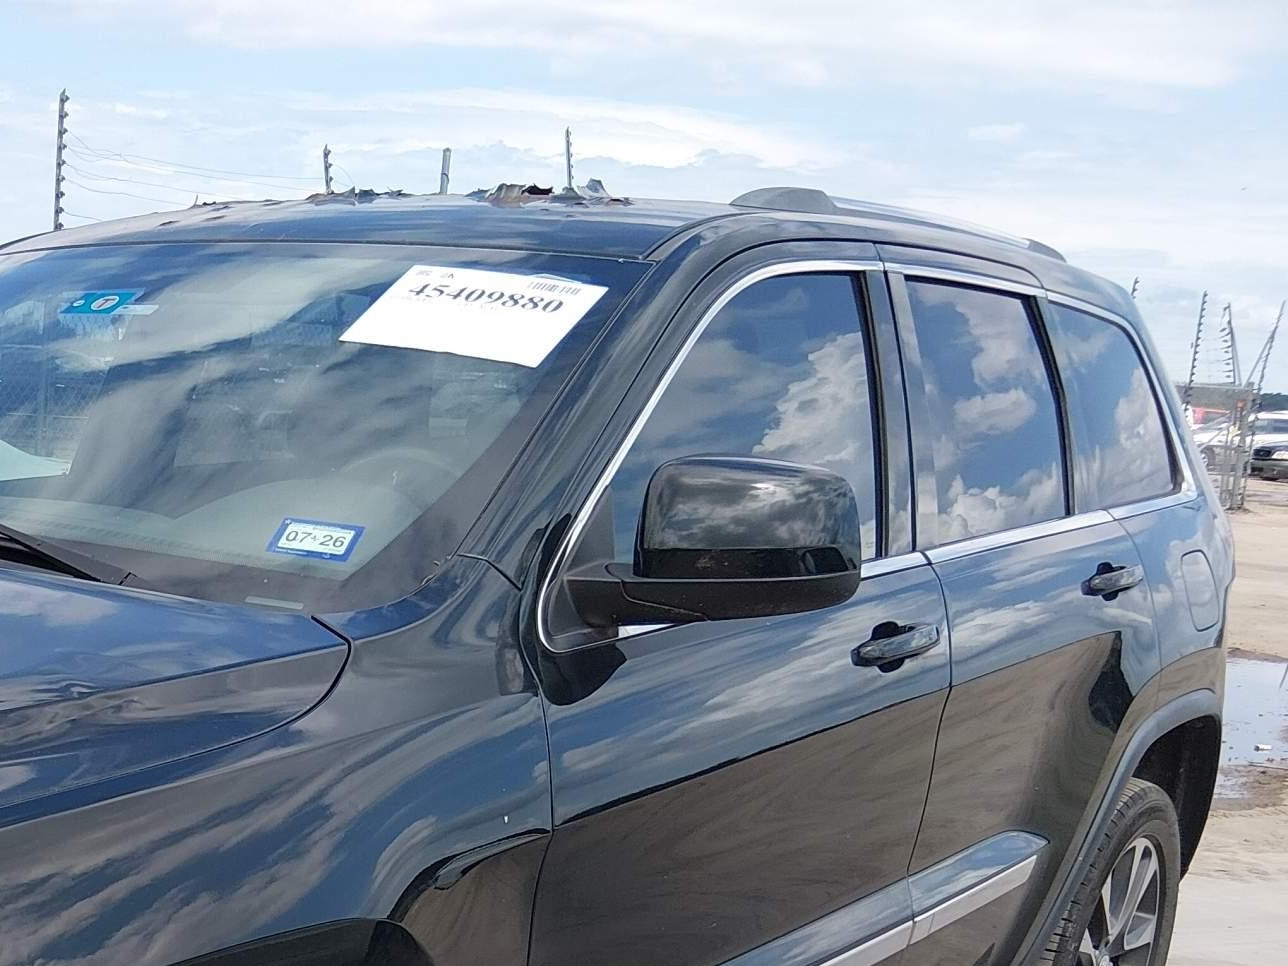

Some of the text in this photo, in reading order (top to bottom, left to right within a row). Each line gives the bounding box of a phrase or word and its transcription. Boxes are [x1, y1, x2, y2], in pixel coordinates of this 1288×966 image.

[408, 282, 564, 314] 45409880
[285, 530, 347, 548] 07 26
